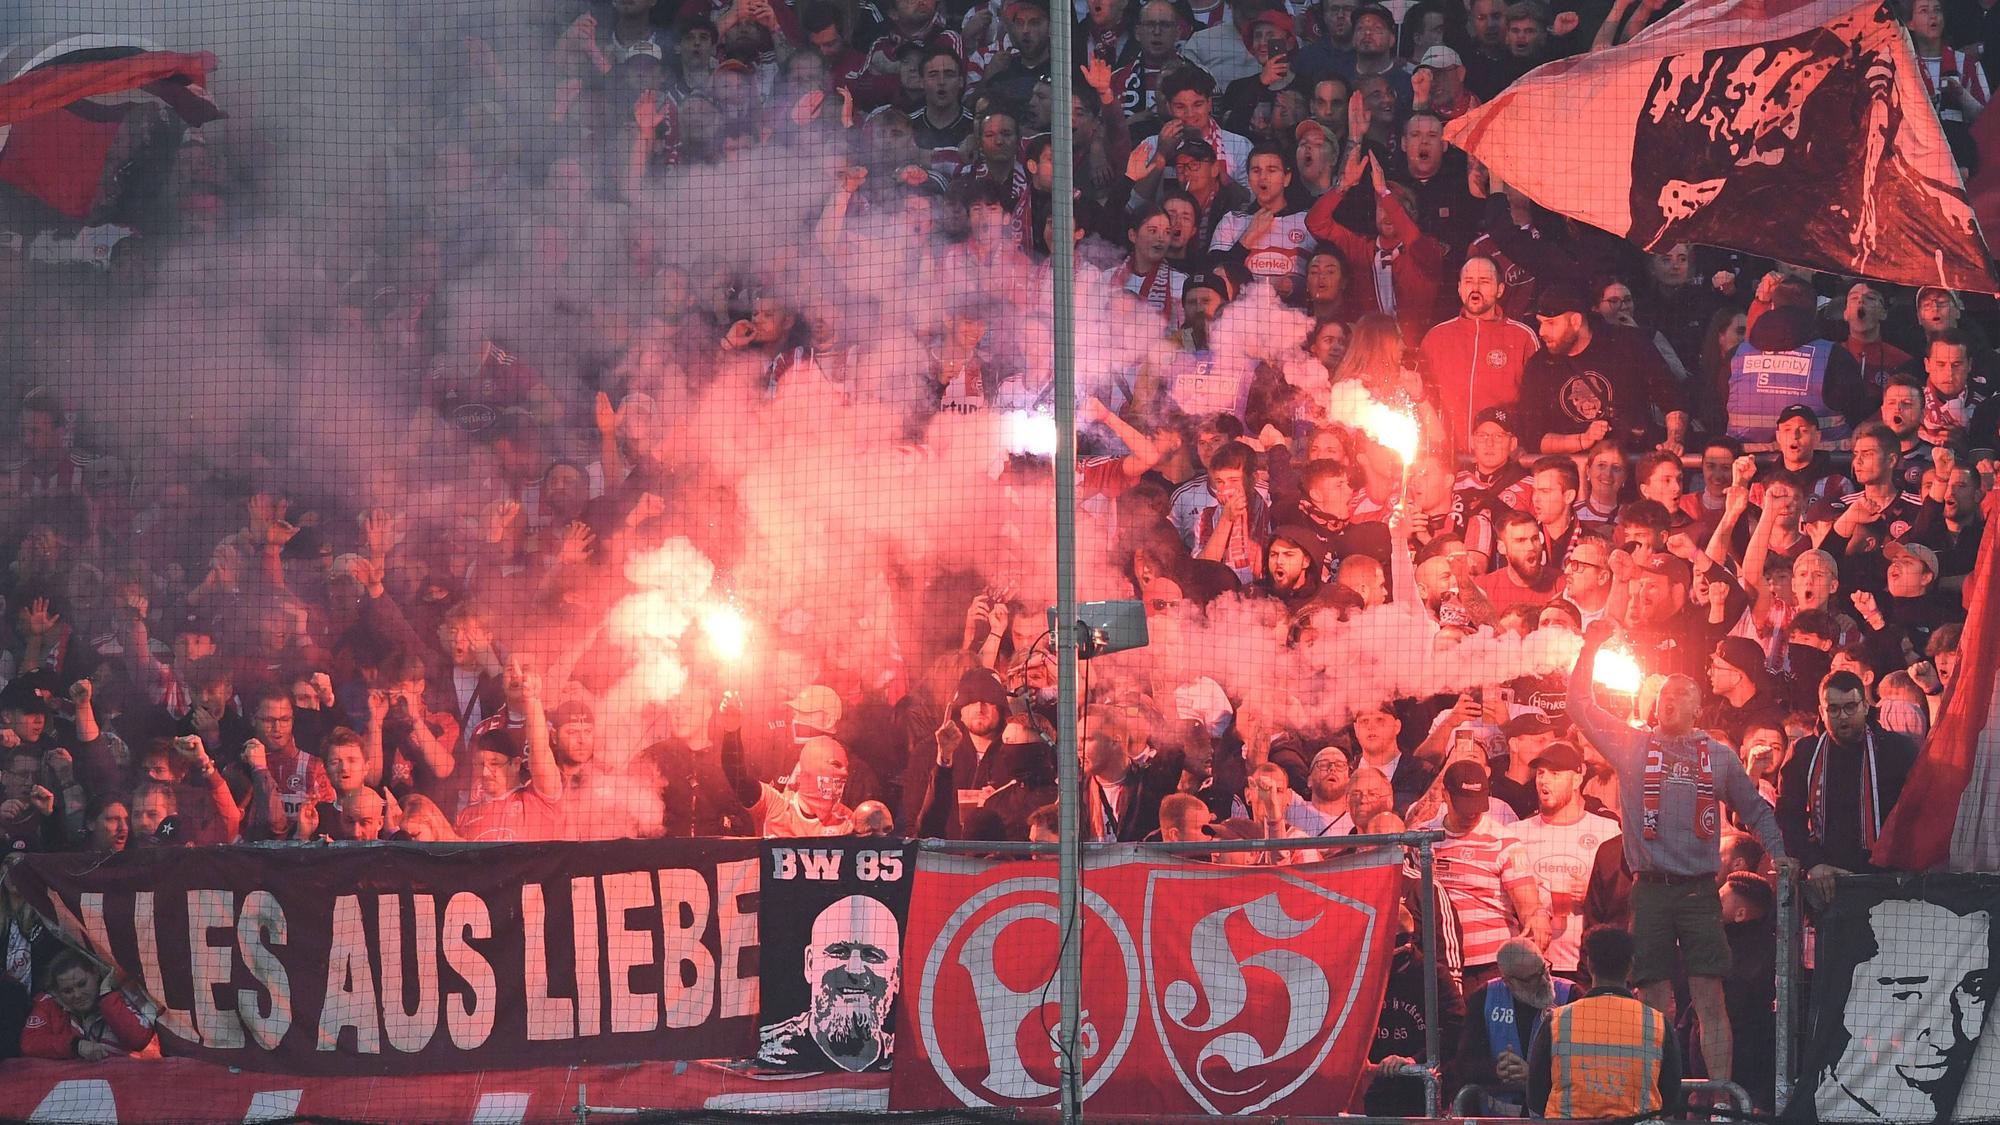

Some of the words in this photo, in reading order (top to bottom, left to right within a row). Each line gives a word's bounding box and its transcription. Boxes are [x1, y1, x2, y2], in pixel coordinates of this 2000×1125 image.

[1250, 258, 1289, 270] Henkel
[1533, 696, 1567, 710] Henke
[771, 847, 844, 880] BW
[855, 849, 903, 881] 85
[1538, 861, 1582, 874] Henkel
[316, 891, 497, 1054] AUS
[521, 858, 760, 1041] LIEBE
